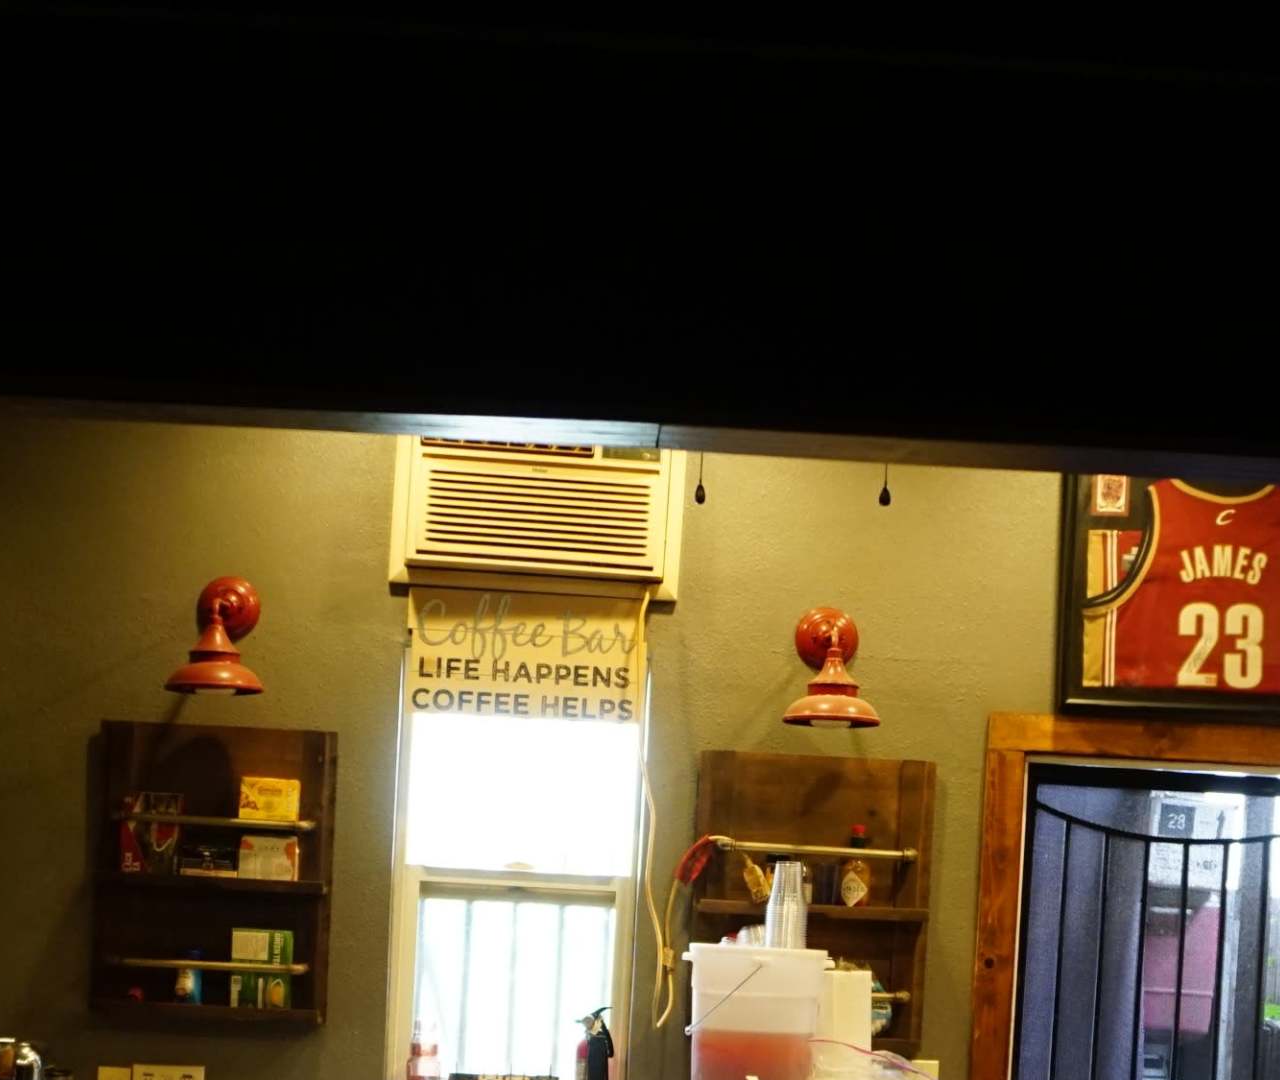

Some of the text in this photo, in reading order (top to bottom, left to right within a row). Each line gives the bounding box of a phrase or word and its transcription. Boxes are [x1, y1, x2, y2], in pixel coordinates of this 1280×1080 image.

[1179, 544, 1268, 586] JAMES
[417, 594, 639, 659] Coffee Bar
[1176, 601, 1265, 690] 23
[418, 656, 631, 690] LIFE HAPPENS
[411, 687, 634, 721] COFFEE HELPS
